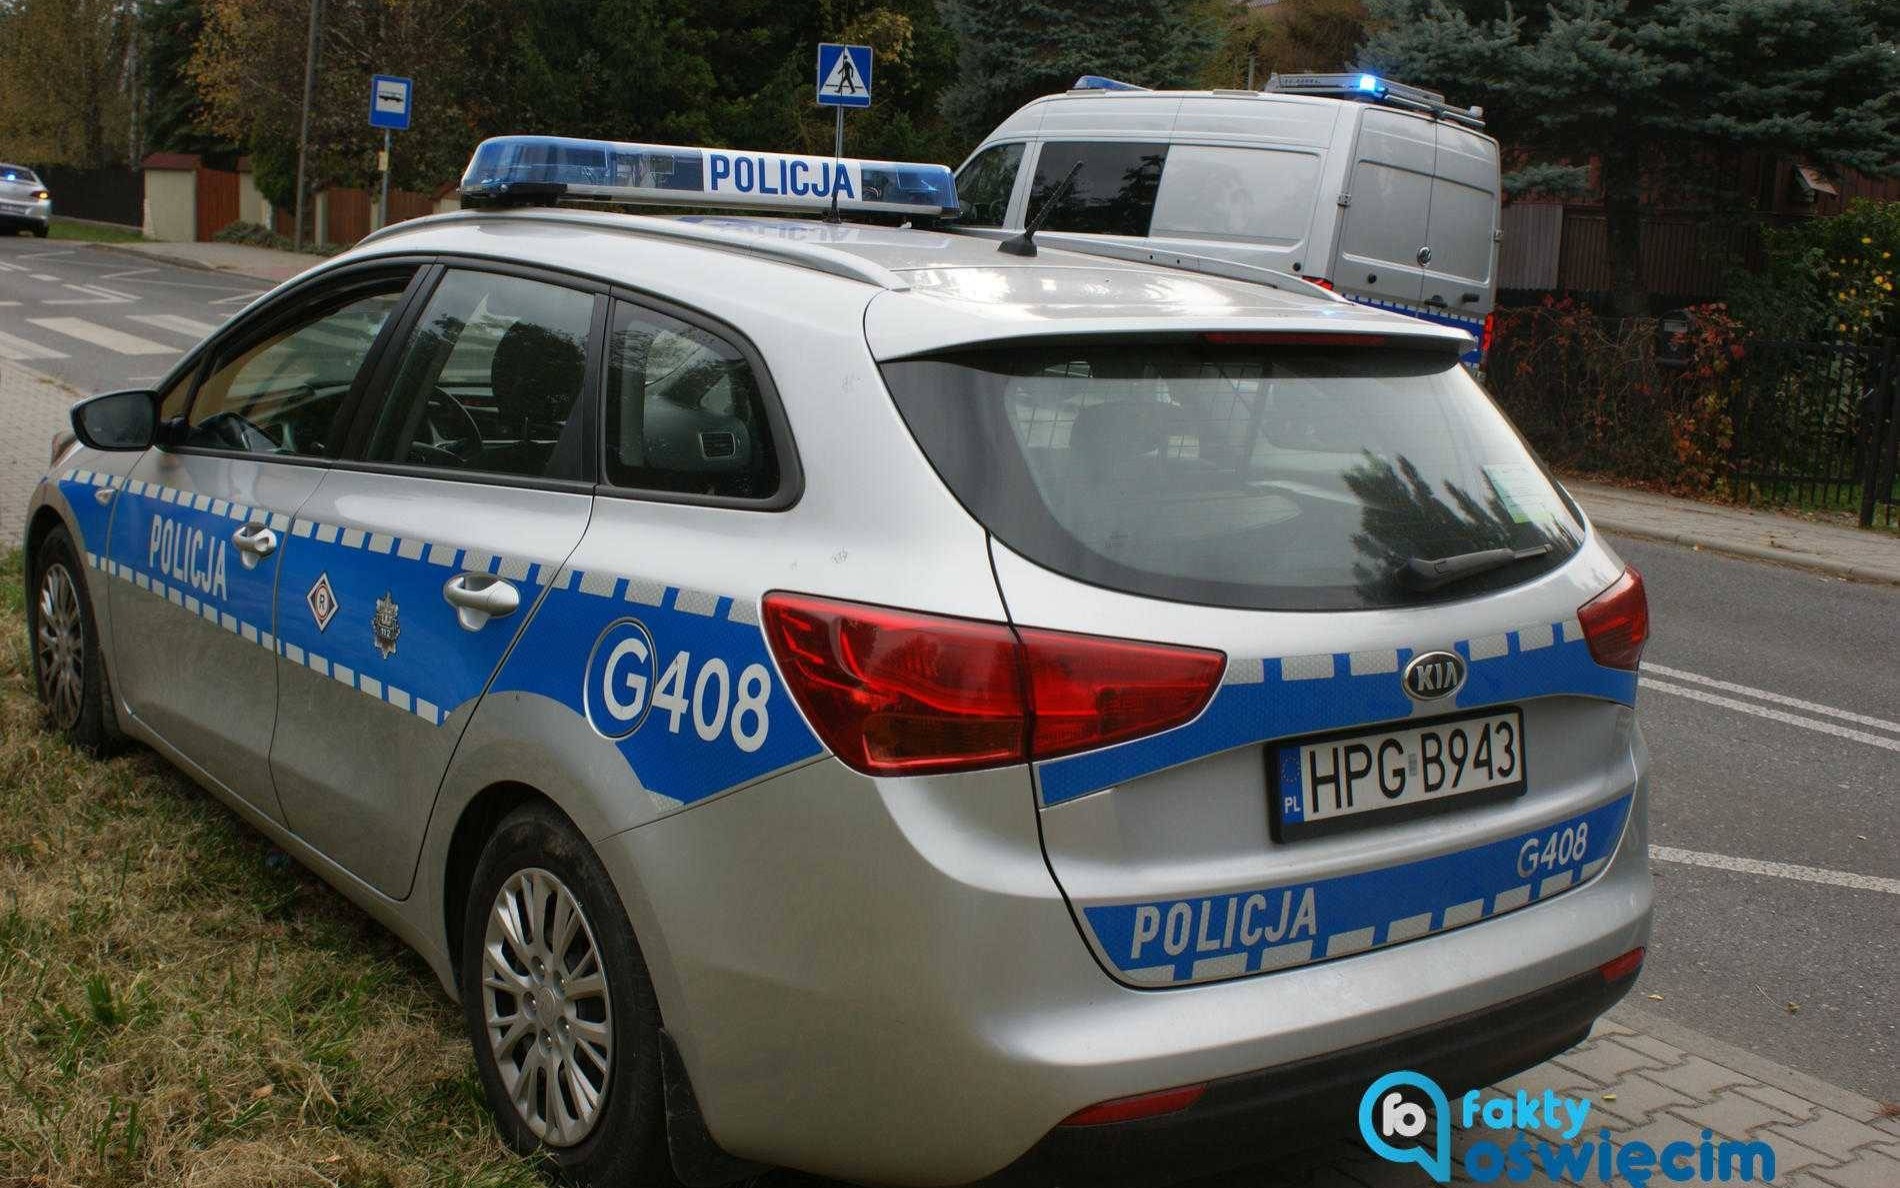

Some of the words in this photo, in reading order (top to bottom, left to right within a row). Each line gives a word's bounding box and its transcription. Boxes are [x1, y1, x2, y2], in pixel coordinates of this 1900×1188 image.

[711, 155, 855, 199] POLICJA
[150, 514, 227, 601] POLICJA
[604, 638, 771, 753] G408
[1416, 660, 1459, 692] KIA
[1309, 739, 1406, 813] HPG
[1420, 721, 1516, 794] B943
[1285, 797, 1300, 813] PL
[1517, 822, 1588, 878] G408
[1132, 888, 1318, 959] POLICJA
